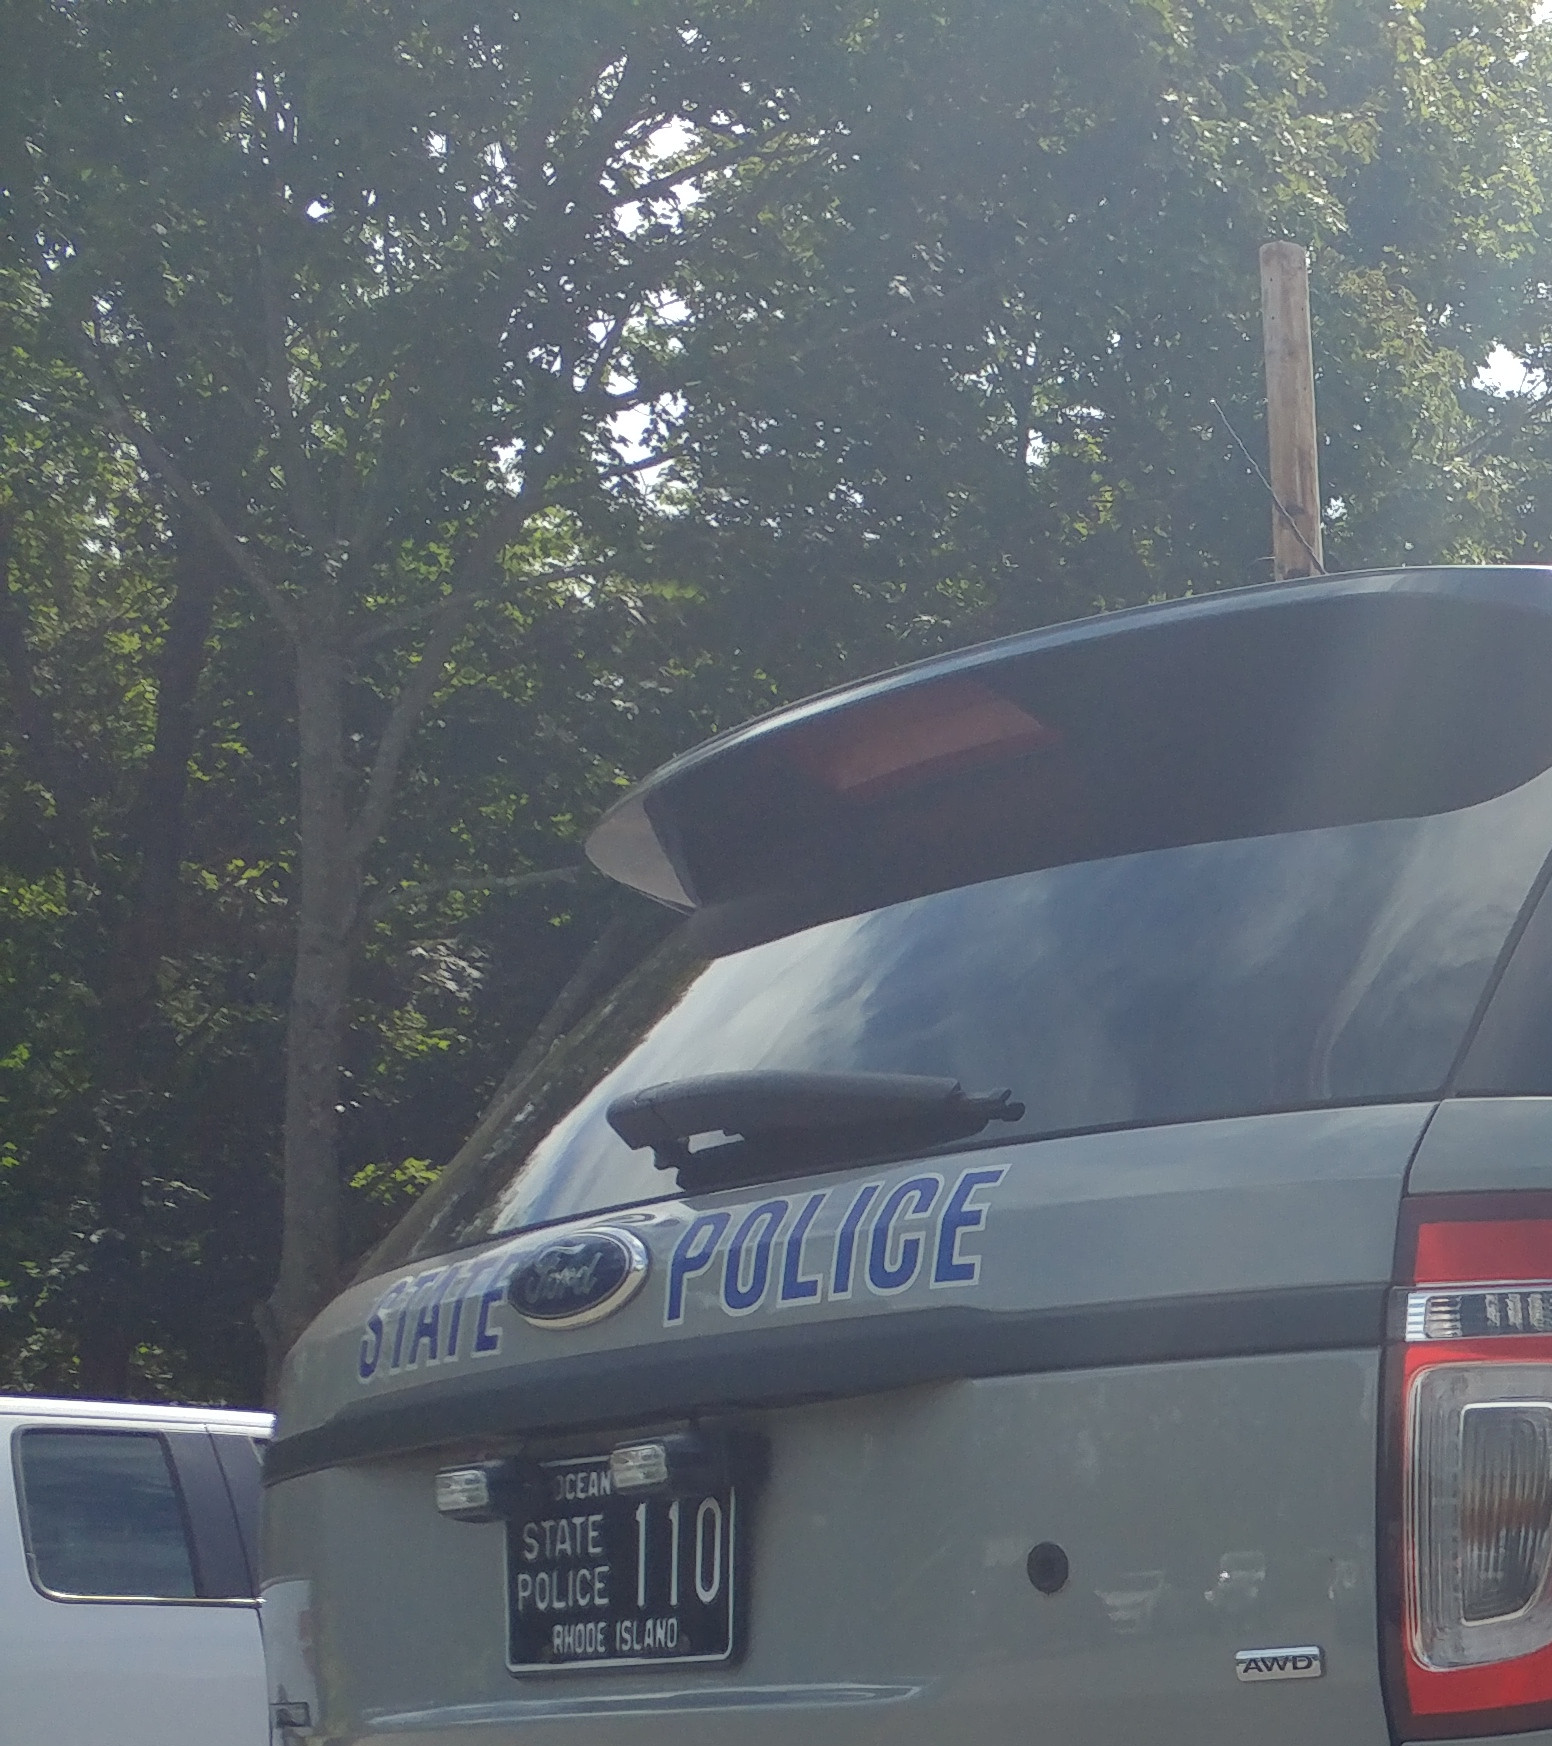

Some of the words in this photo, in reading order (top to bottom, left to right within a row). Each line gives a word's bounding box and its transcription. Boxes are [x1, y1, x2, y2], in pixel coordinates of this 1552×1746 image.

[356, 1254, 512, 1384] STATE
[663, 1163, 1012, 1328] POLICE
[522, 1514, 604, 1561] STATE
[635, 1496, 722, 1608] 110
[517, 1566, 610, 1611] POLICE
[553, 1621, 608, 1654] RHODE
[616, 1618, 678, 1651] ISLAND
[1242, 1655, 1313, 1674] AWD
